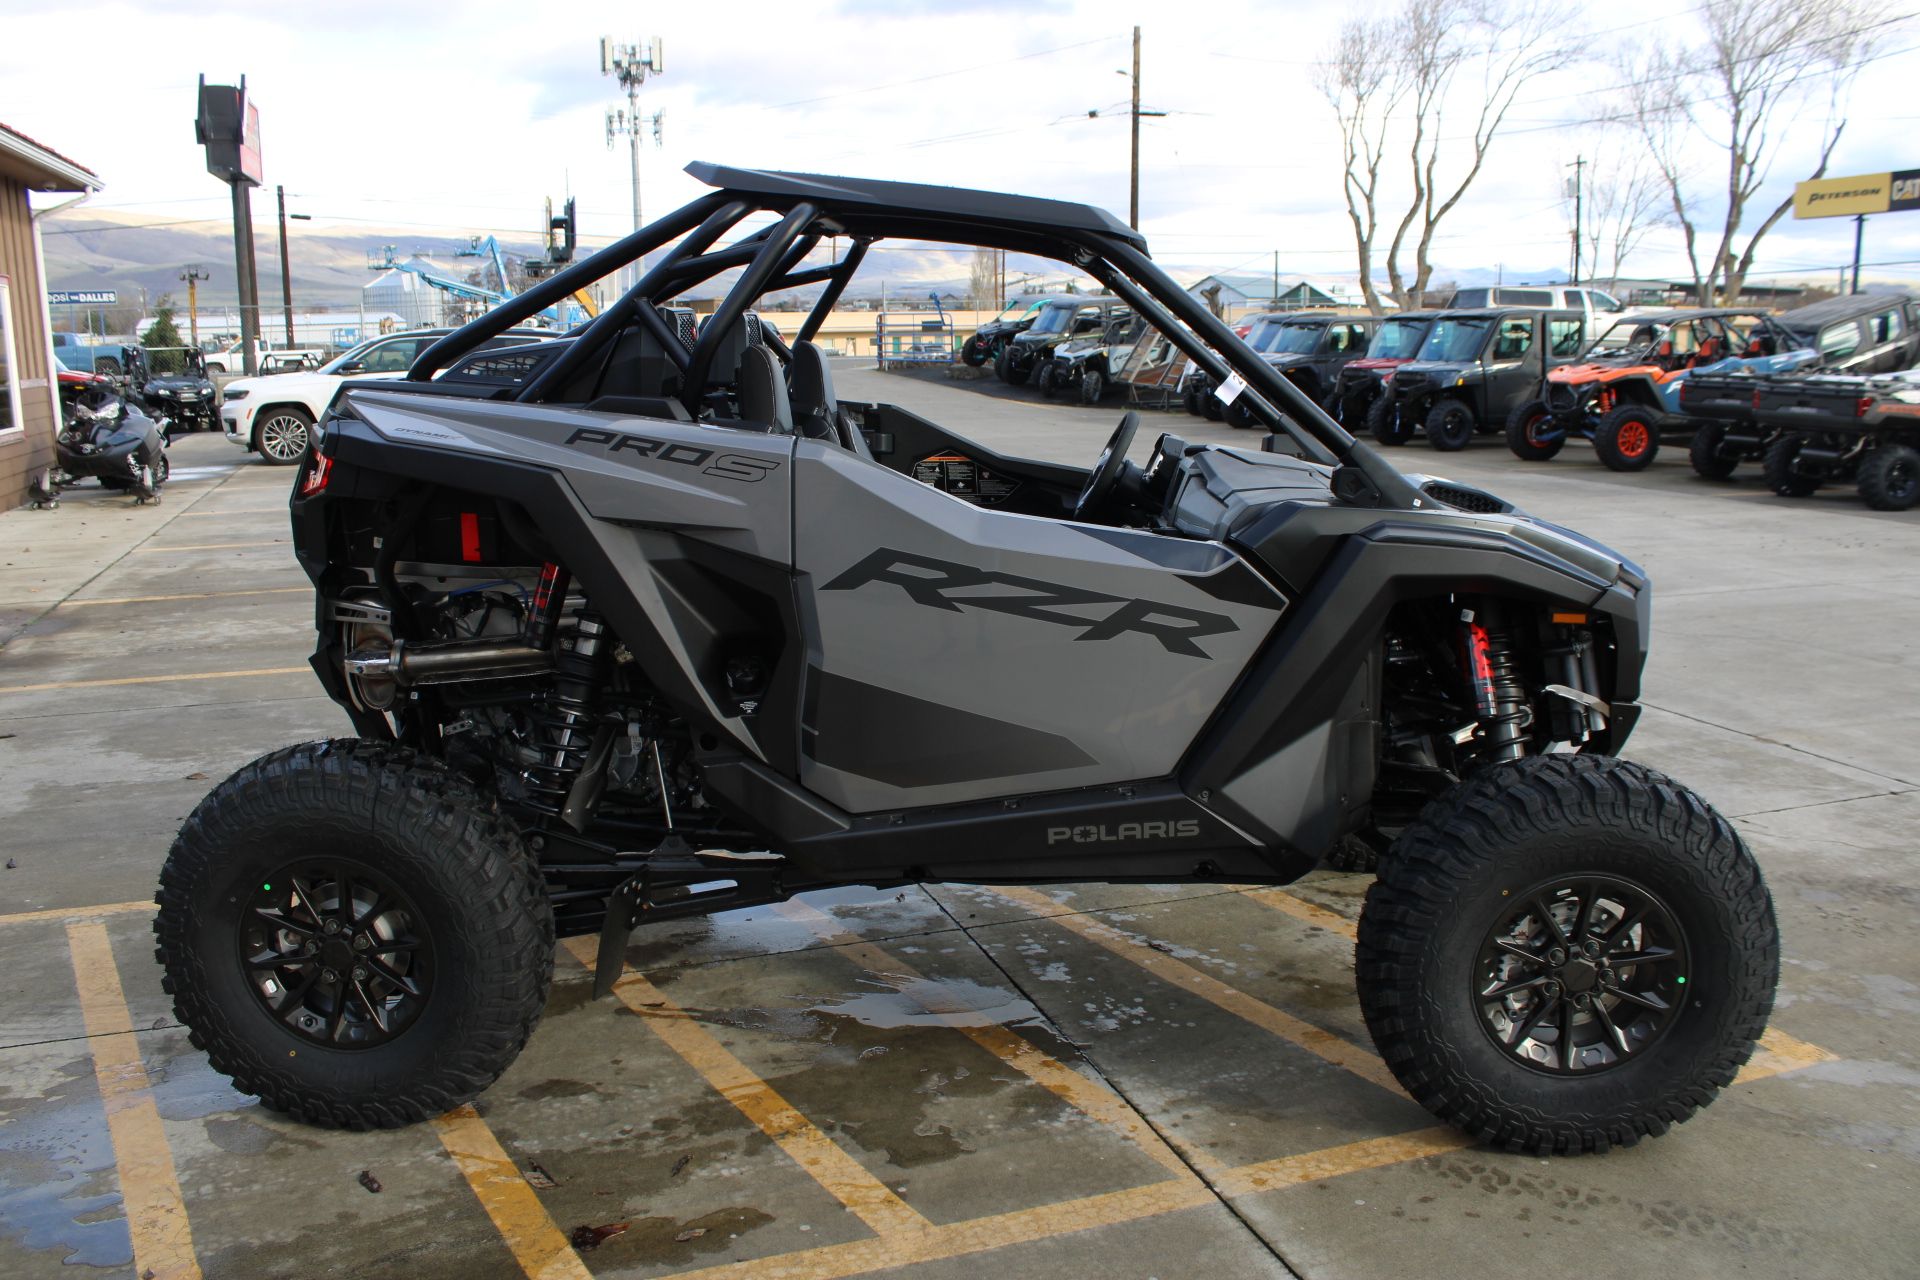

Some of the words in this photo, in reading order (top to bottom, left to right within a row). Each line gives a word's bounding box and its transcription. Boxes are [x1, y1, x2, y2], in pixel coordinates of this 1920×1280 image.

[1807, 187, 1882, 205] PETERSON
[48, 292, 70, 303] epsi
[79, 293, 115, 302] DALLES
[564, 428, 714, 467] PRO
[702, 453, 781, 483] S
[818, 546, 1241, 661] RZR
[1047, 819, 1201, 846] POLARIS
